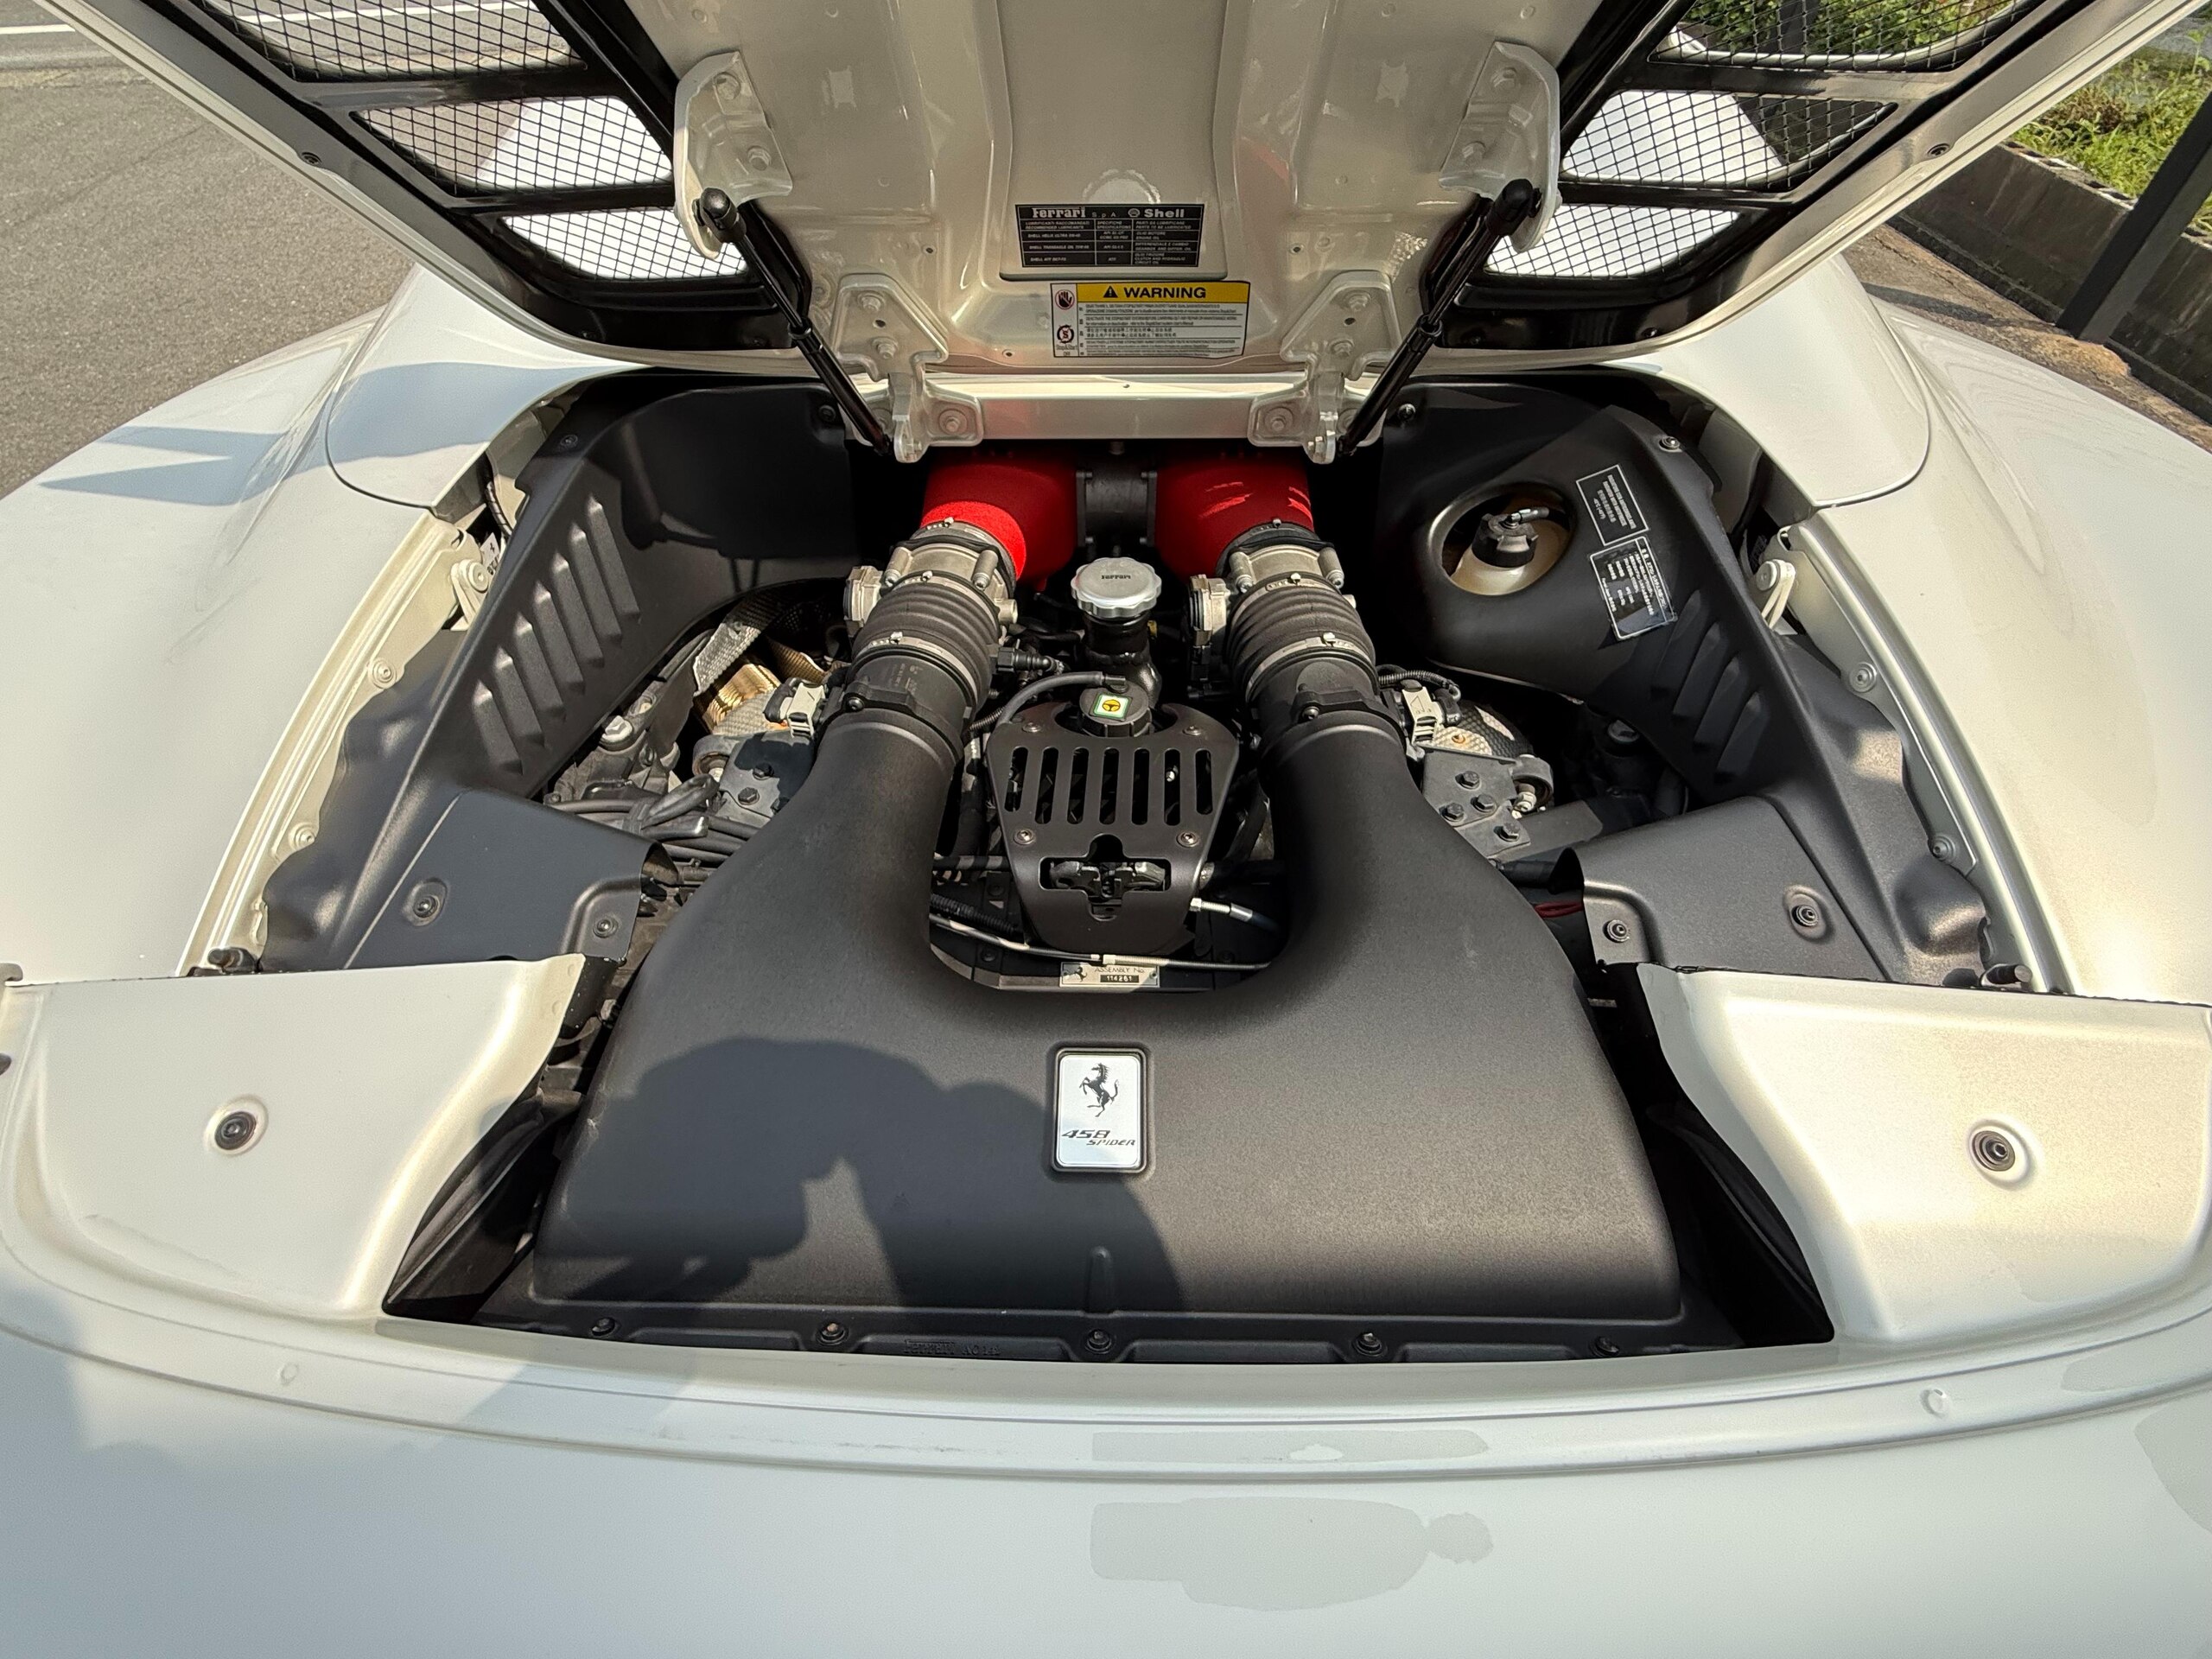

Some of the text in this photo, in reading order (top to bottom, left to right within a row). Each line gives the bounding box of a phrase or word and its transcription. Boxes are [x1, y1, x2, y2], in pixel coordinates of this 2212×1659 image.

[1032, 207, 1086, 218] Ferrari
[1144, 208, 1184, 218] Shell
[1124, 287, 1206, 298] WARNING
[1061, 1129, 1111, 1139] 458
